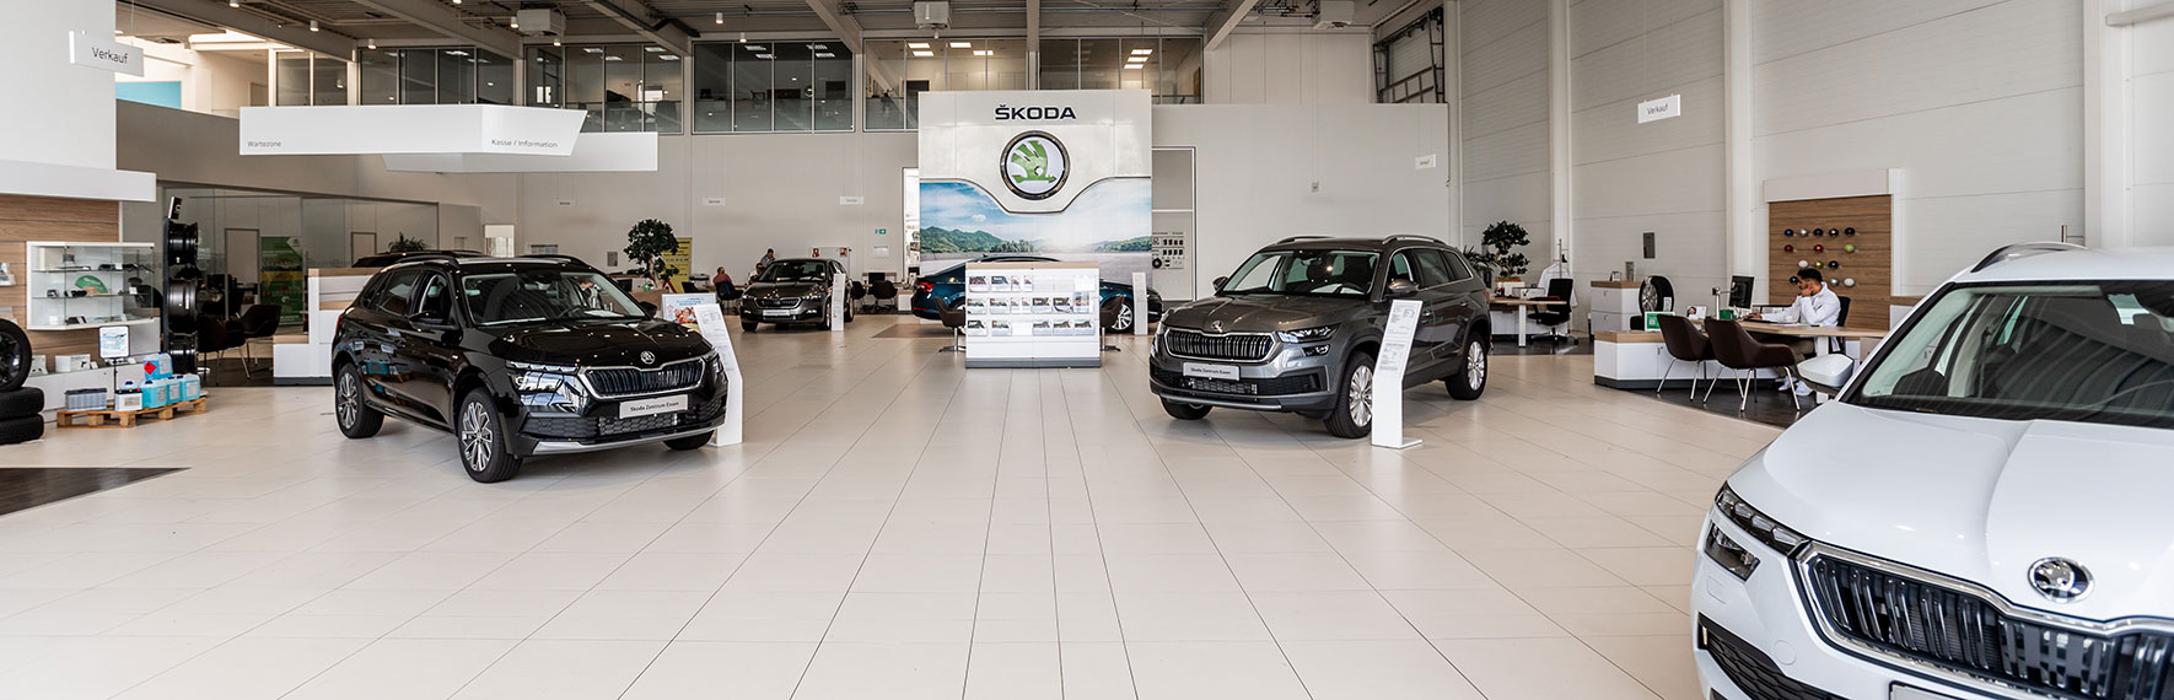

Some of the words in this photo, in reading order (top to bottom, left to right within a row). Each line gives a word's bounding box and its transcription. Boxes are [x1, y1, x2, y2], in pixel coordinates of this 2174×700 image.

[91, 47, 129, 64] Verkauf
[995, 104, 1077, 120] ŠKODA
[1647, 103, 1669, 115] Verkauf
[518, 140, 559, 148] Information
